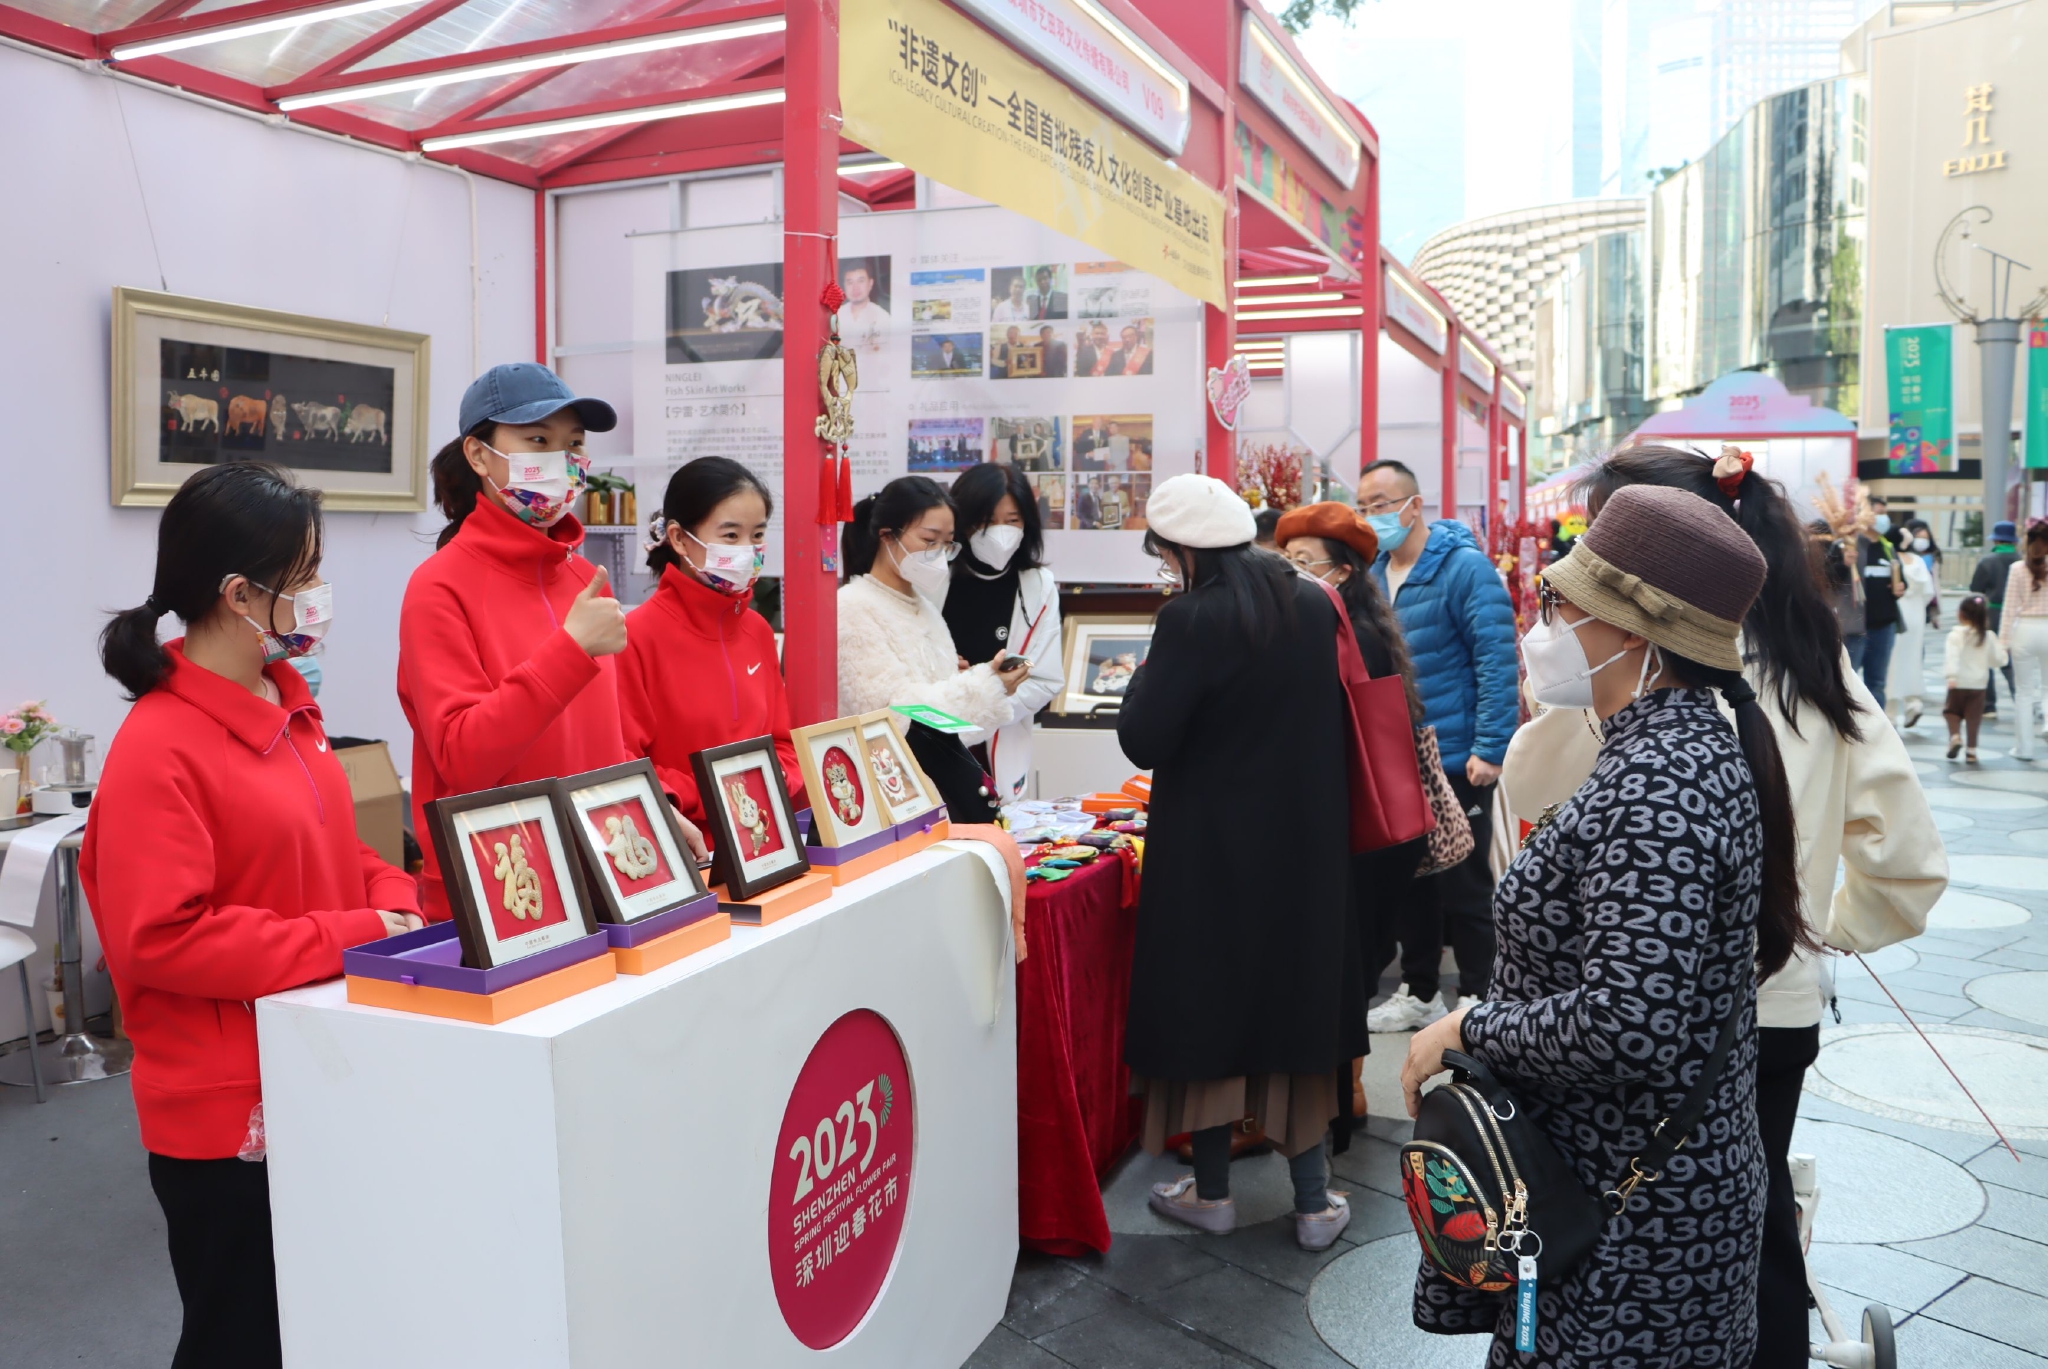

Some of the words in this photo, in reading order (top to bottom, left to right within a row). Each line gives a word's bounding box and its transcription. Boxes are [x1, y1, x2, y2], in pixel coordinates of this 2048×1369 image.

[889, 68, 934, 105] ICH-LEGACY
[935, 94, 971, 126] CULTURAL
[665, 373, 702, 382] NINGLEI
[665, 386, 684, 396] Fish
[685, 385, 703, 395] Skin
[705, 385, 719, 394] Art
[720, 384, 746, 394] Works
[789, 1079, 878, 1206] 2023
[794, 1167, 856, 1235] SHENZHEN
[795, 1225, 822, 1253] SPRING
[823, 1196, 855, 1228] FESTIVAL
[855, 1167, 881, 1198] FLOWER
[882, 1153, 897, 1175] FAIR
[795, 1176, 898, 1287] 深圳迎春花市
[1520, 1291, 1532, 1324] BEIJING
